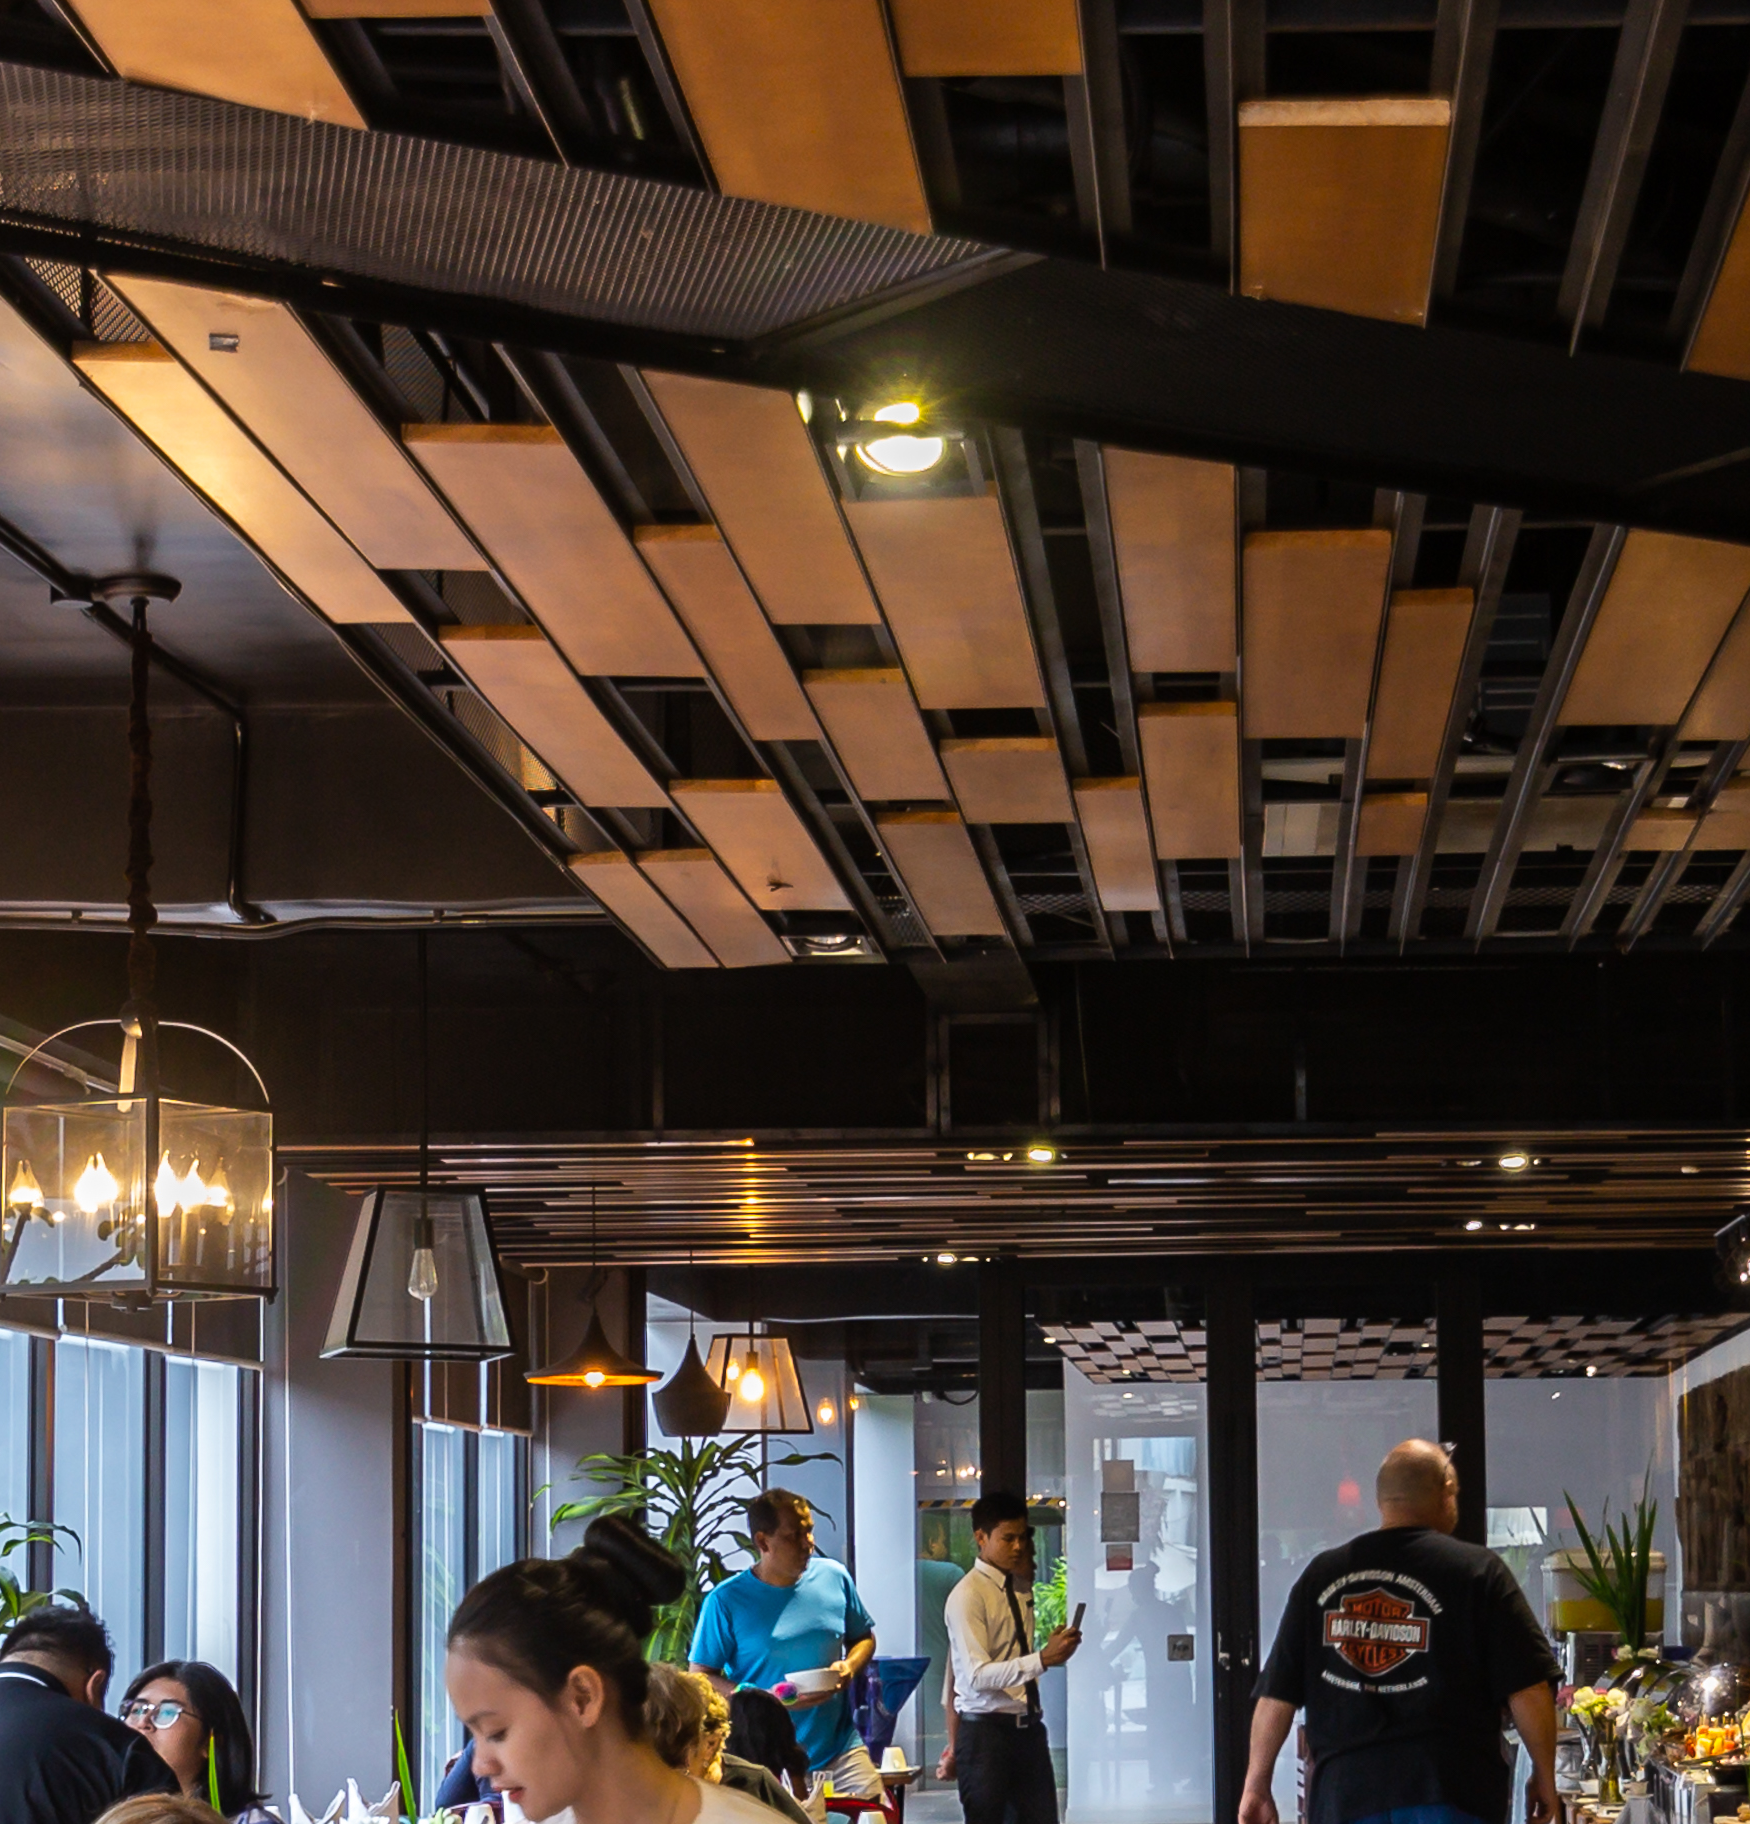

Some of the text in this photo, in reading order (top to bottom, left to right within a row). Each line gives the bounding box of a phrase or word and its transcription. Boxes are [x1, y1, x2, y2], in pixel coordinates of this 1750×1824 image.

[1352, 1598, 1402, 1618] MOTOR
[1394, 1574, 1443, 1616] AMSTERDAM
[1331, 1618, 1421, 1643] HARLEY-DAVIDSON
[1348, 1641, 1398, 1668] CYCLES
